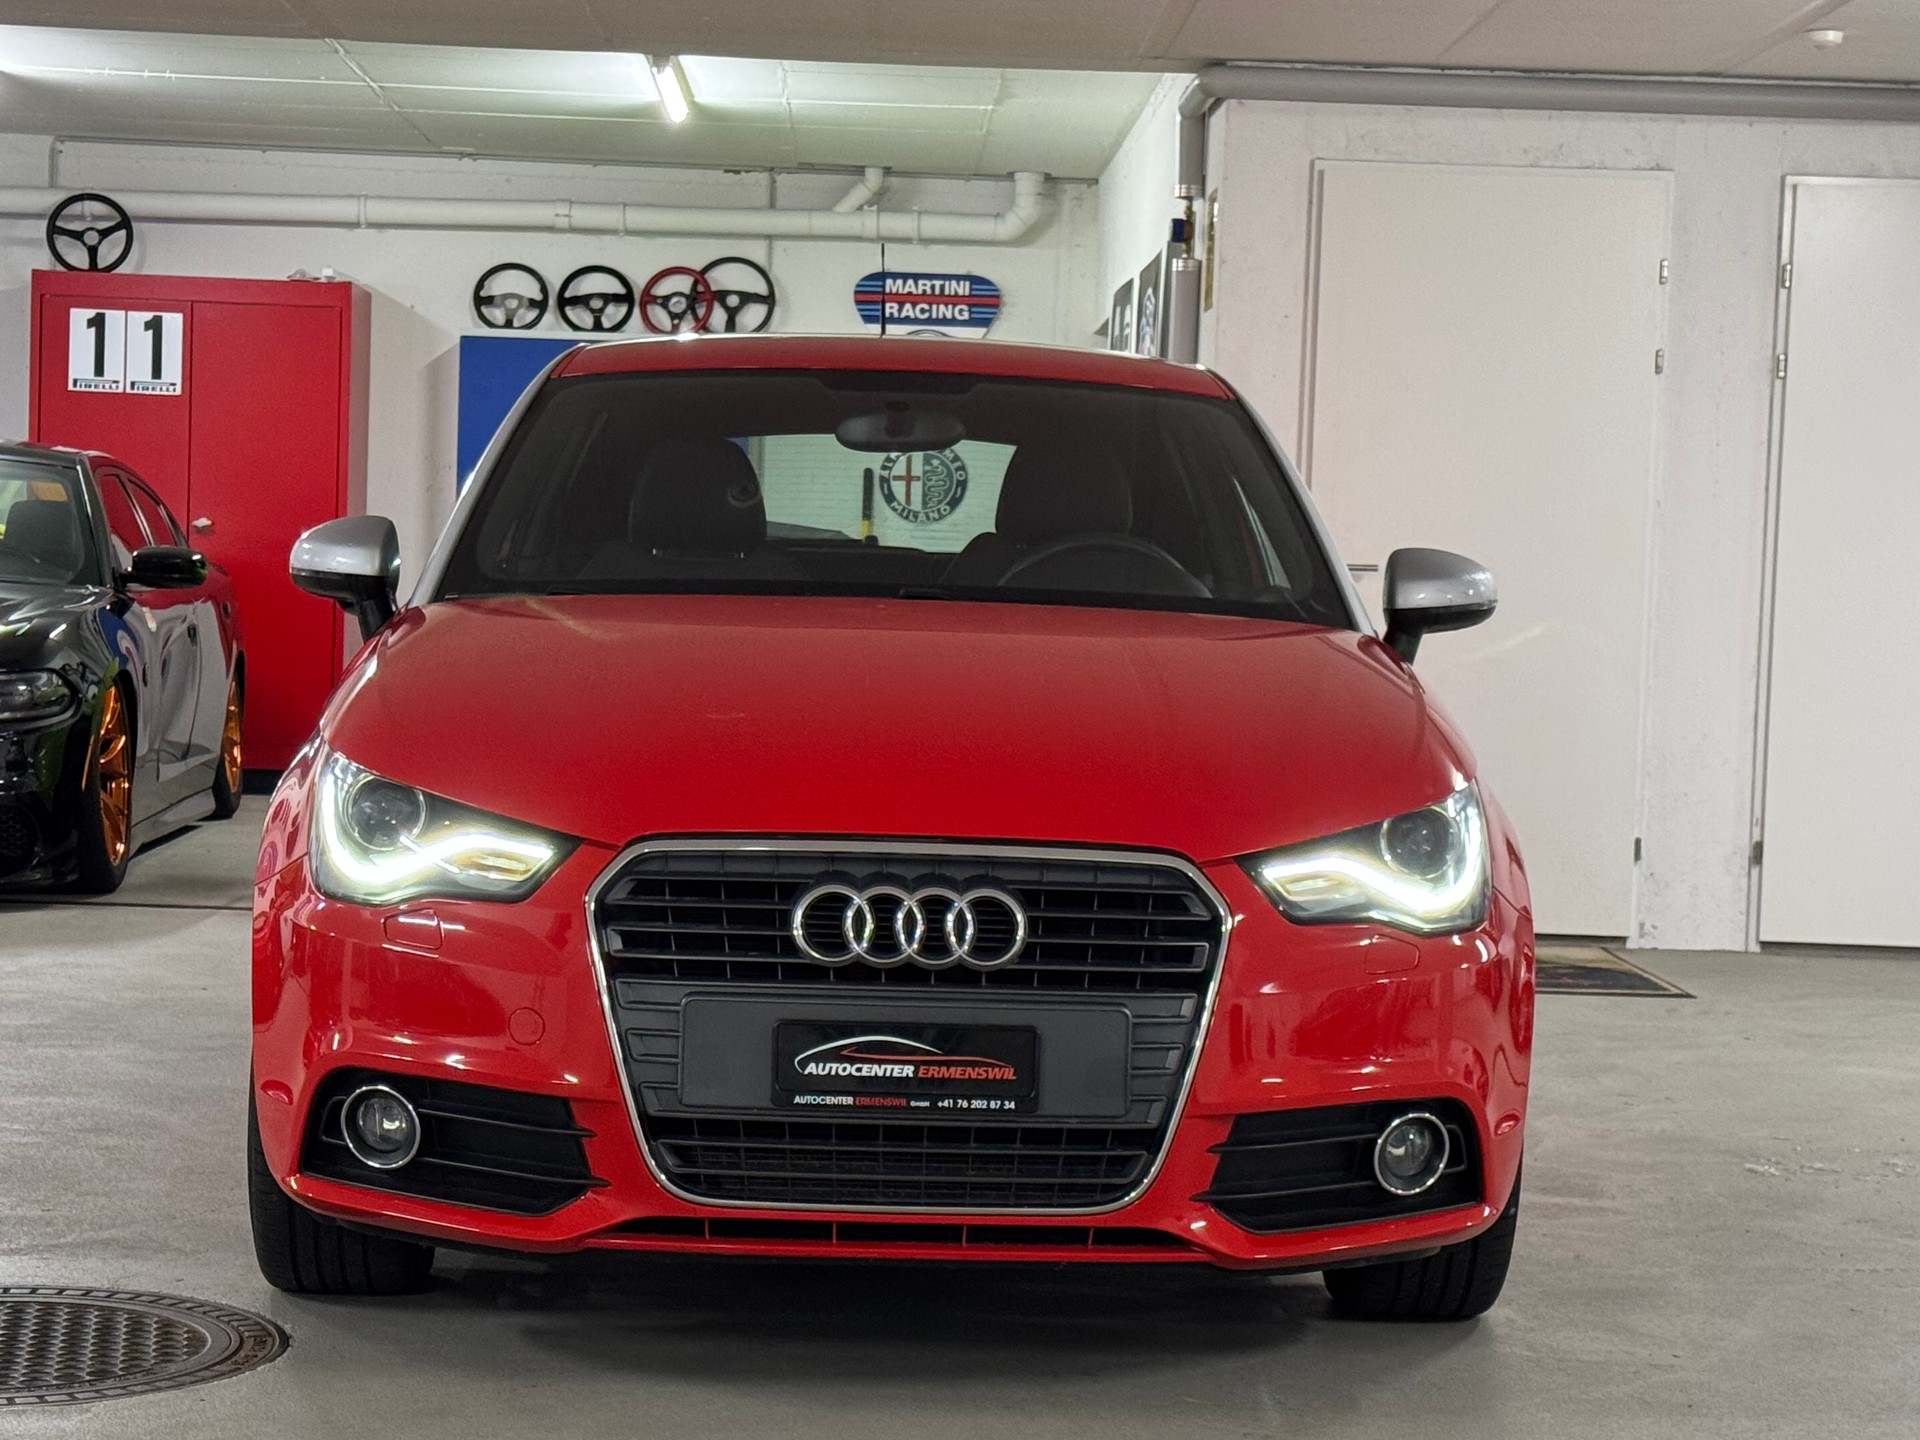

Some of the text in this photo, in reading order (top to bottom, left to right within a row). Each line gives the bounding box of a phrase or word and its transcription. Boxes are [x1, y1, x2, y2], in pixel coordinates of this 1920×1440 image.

[885, 278, 971, 296] MARTINI
[885, 302, 970, 320] RACING
[942, 449, 966, 481] MEO
[890, 501, 951, 524] MILANO
[803, 1062, 1017, 1080] AUTOCENTER ERMENSWIL
[793, 1095, 854, 1106] AUTOCENTER
[855, 1096, 908, 1107] ERMENSWIL
[937, 1098, 954, 1108] +41
[956, 1098, 969, 1109] 76
[970, 1099, 988, 1109] 202
[989, 1100, 1001, 1110] 87
[1003, 1100, 1016, 1110] 34
